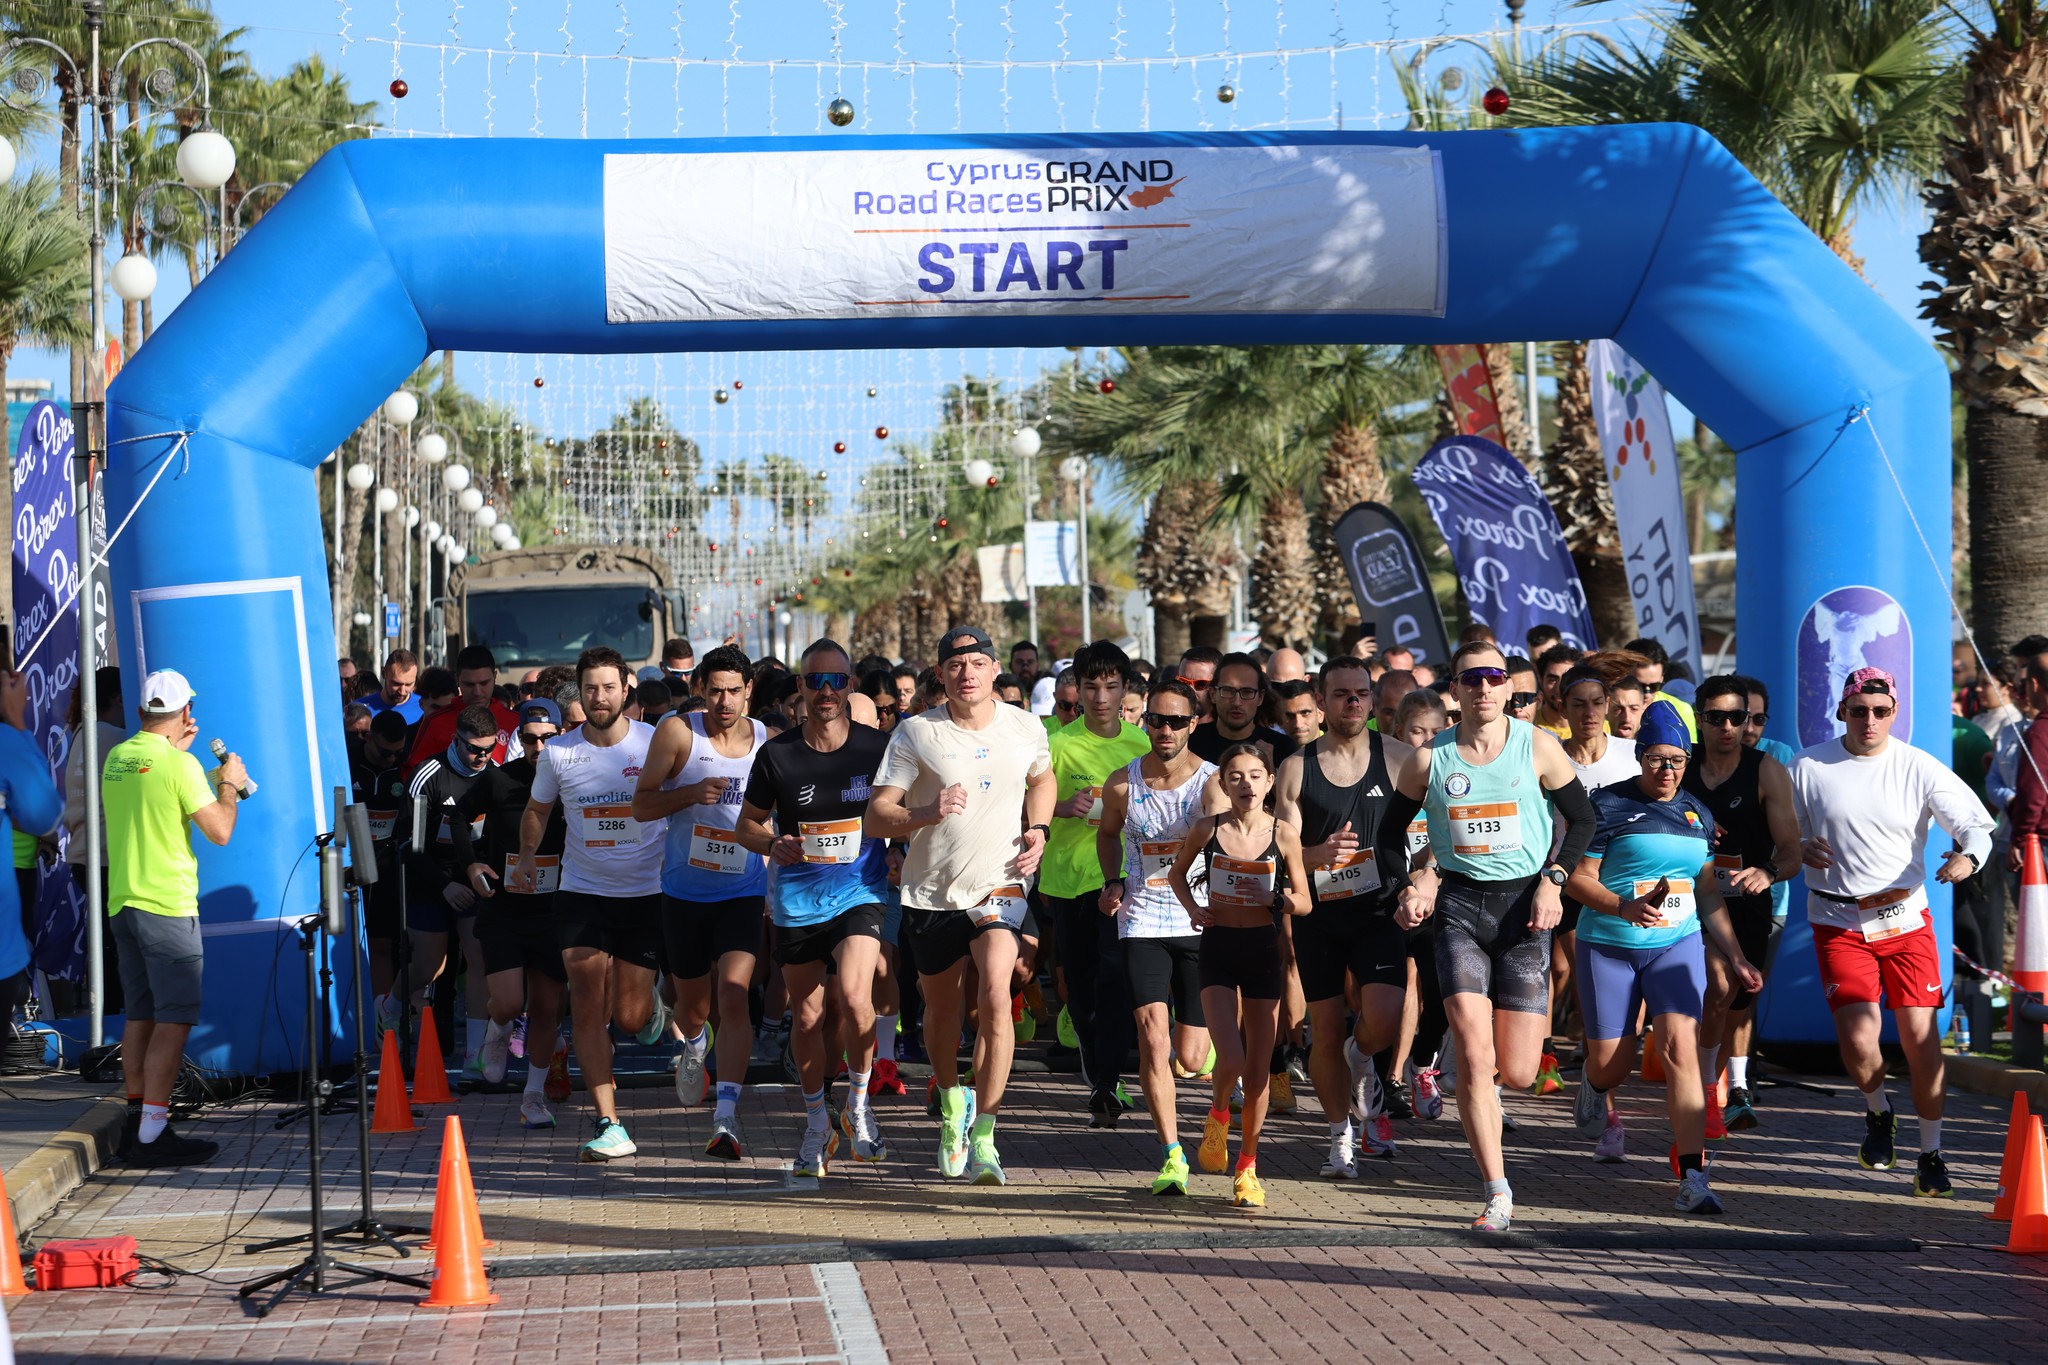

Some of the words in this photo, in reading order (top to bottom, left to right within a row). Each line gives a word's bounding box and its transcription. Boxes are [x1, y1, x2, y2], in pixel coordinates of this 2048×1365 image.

[927, 161, 1041, 186] Cyprus
[1046, 159, 1173, 184] GRAND
[854, 189, 938, 215] Road
[946, 190, 1042, 214] Races
[1048, 185, 1129, 212] PRIX
[917, 239, 1129, 293] START
[17, 491, 67, 576] Parex
[850, 775, 867, 789] ICE
[578, 791, 633, 804] eurolife
[841, 786, 873, 802] POWE
[598, 820, 626, 831] 5286
[1468, 820, 1501, 834] 5133
[706, 842, 735, 856] 5314
[817, 836, 847, 847] 5237
[1331, 867, 1361, 883] 5105
[1877, 903, 1906, 920] 5209
